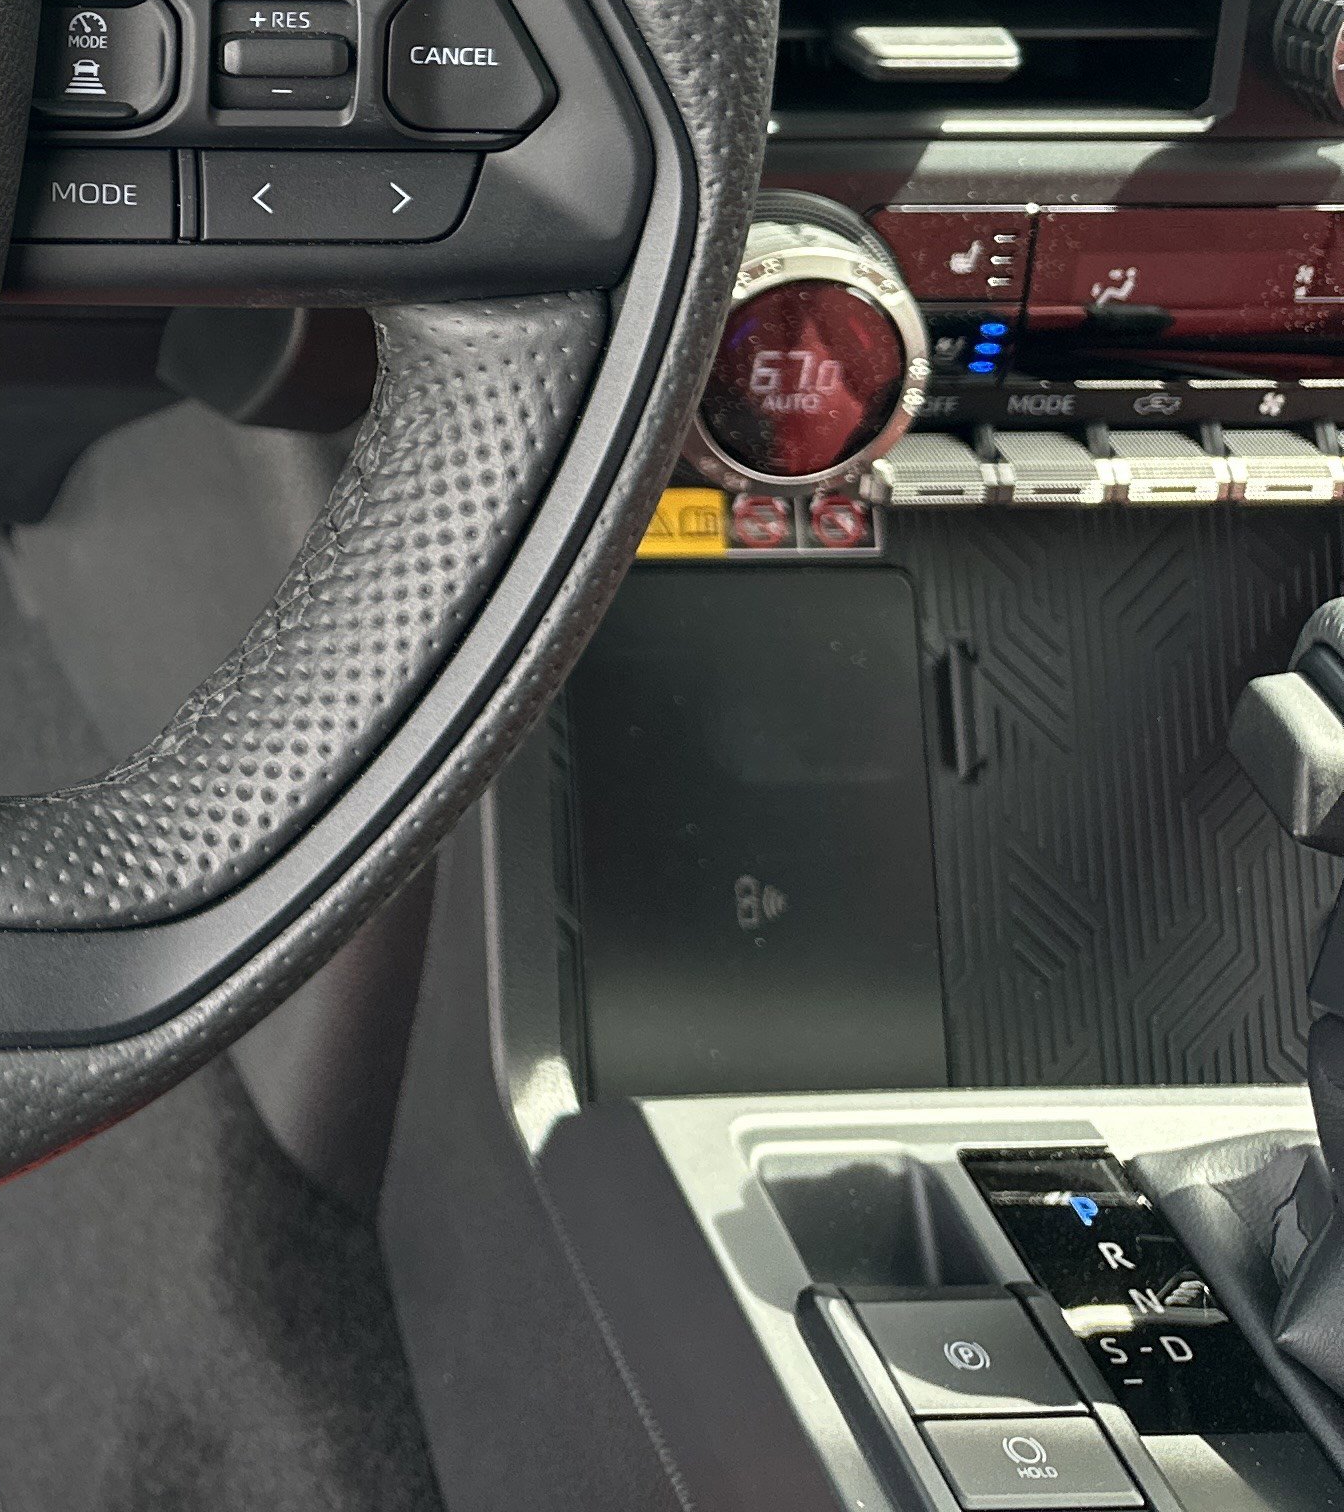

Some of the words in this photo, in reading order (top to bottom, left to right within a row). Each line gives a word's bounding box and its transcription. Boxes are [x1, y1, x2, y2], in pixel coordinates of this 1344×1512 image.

[67, 35, 108, 50] MODE
[409, 45, 500, 68] CANCEL
[50, 182, 138, 207] MODE
[760, 394, 822, 412] AUTO
[1007, 394, 1076, 415] MODE
[1069, 1196, 1100, 1227] P
[1097, 1241, 1135, 1270] R
[1128, 1288, 1165, 1315] N
[1100, 1337, 1129, 1365] S
[1159, 1335, 1194, 1363] D
[1016, 1466, 1060, 1480] HOLD
